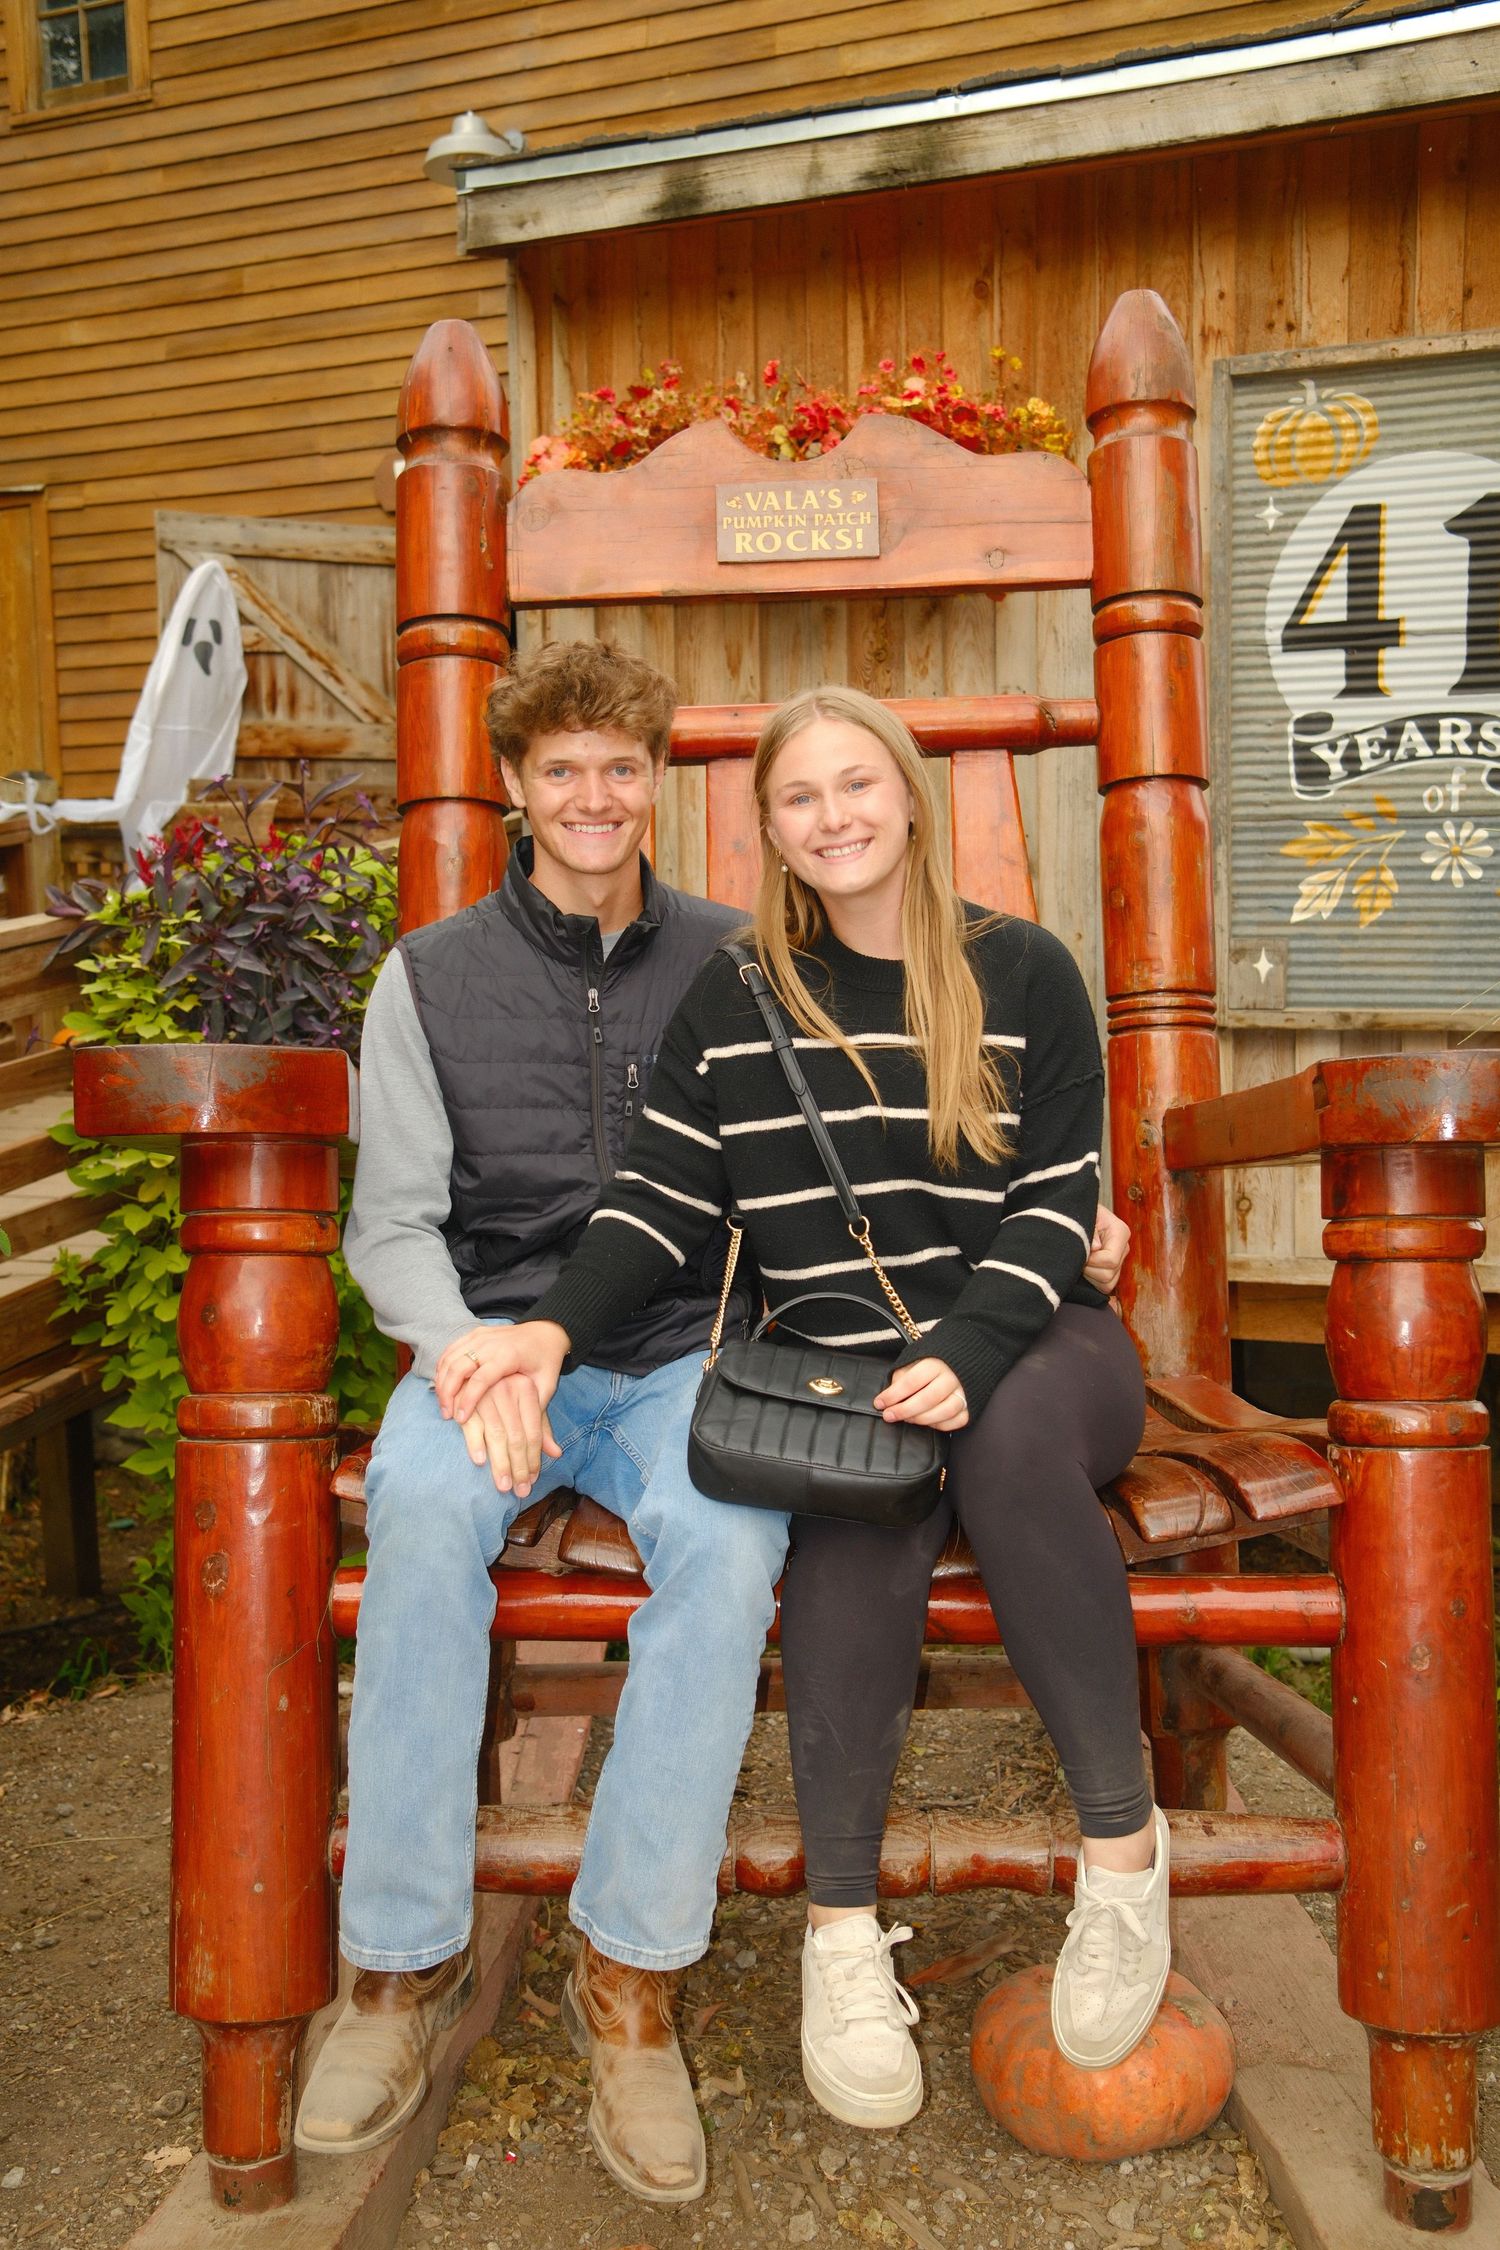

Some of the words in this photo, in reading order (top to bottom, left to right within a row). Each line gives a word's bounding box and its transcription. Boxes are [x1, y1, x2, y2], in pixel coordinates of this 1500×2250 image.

[744, 488, 842, 512] VALA'S
[722, 514, 807, 529] PUMPKIN
[815, 511, 871, 526] PATCH
[735, 528, 864, 554] ROCKS!
[1281, 492, 1500, 699] 41
[1311, 717, 1500, 781] YEARS
[1422, 766, 1466, 812] of
